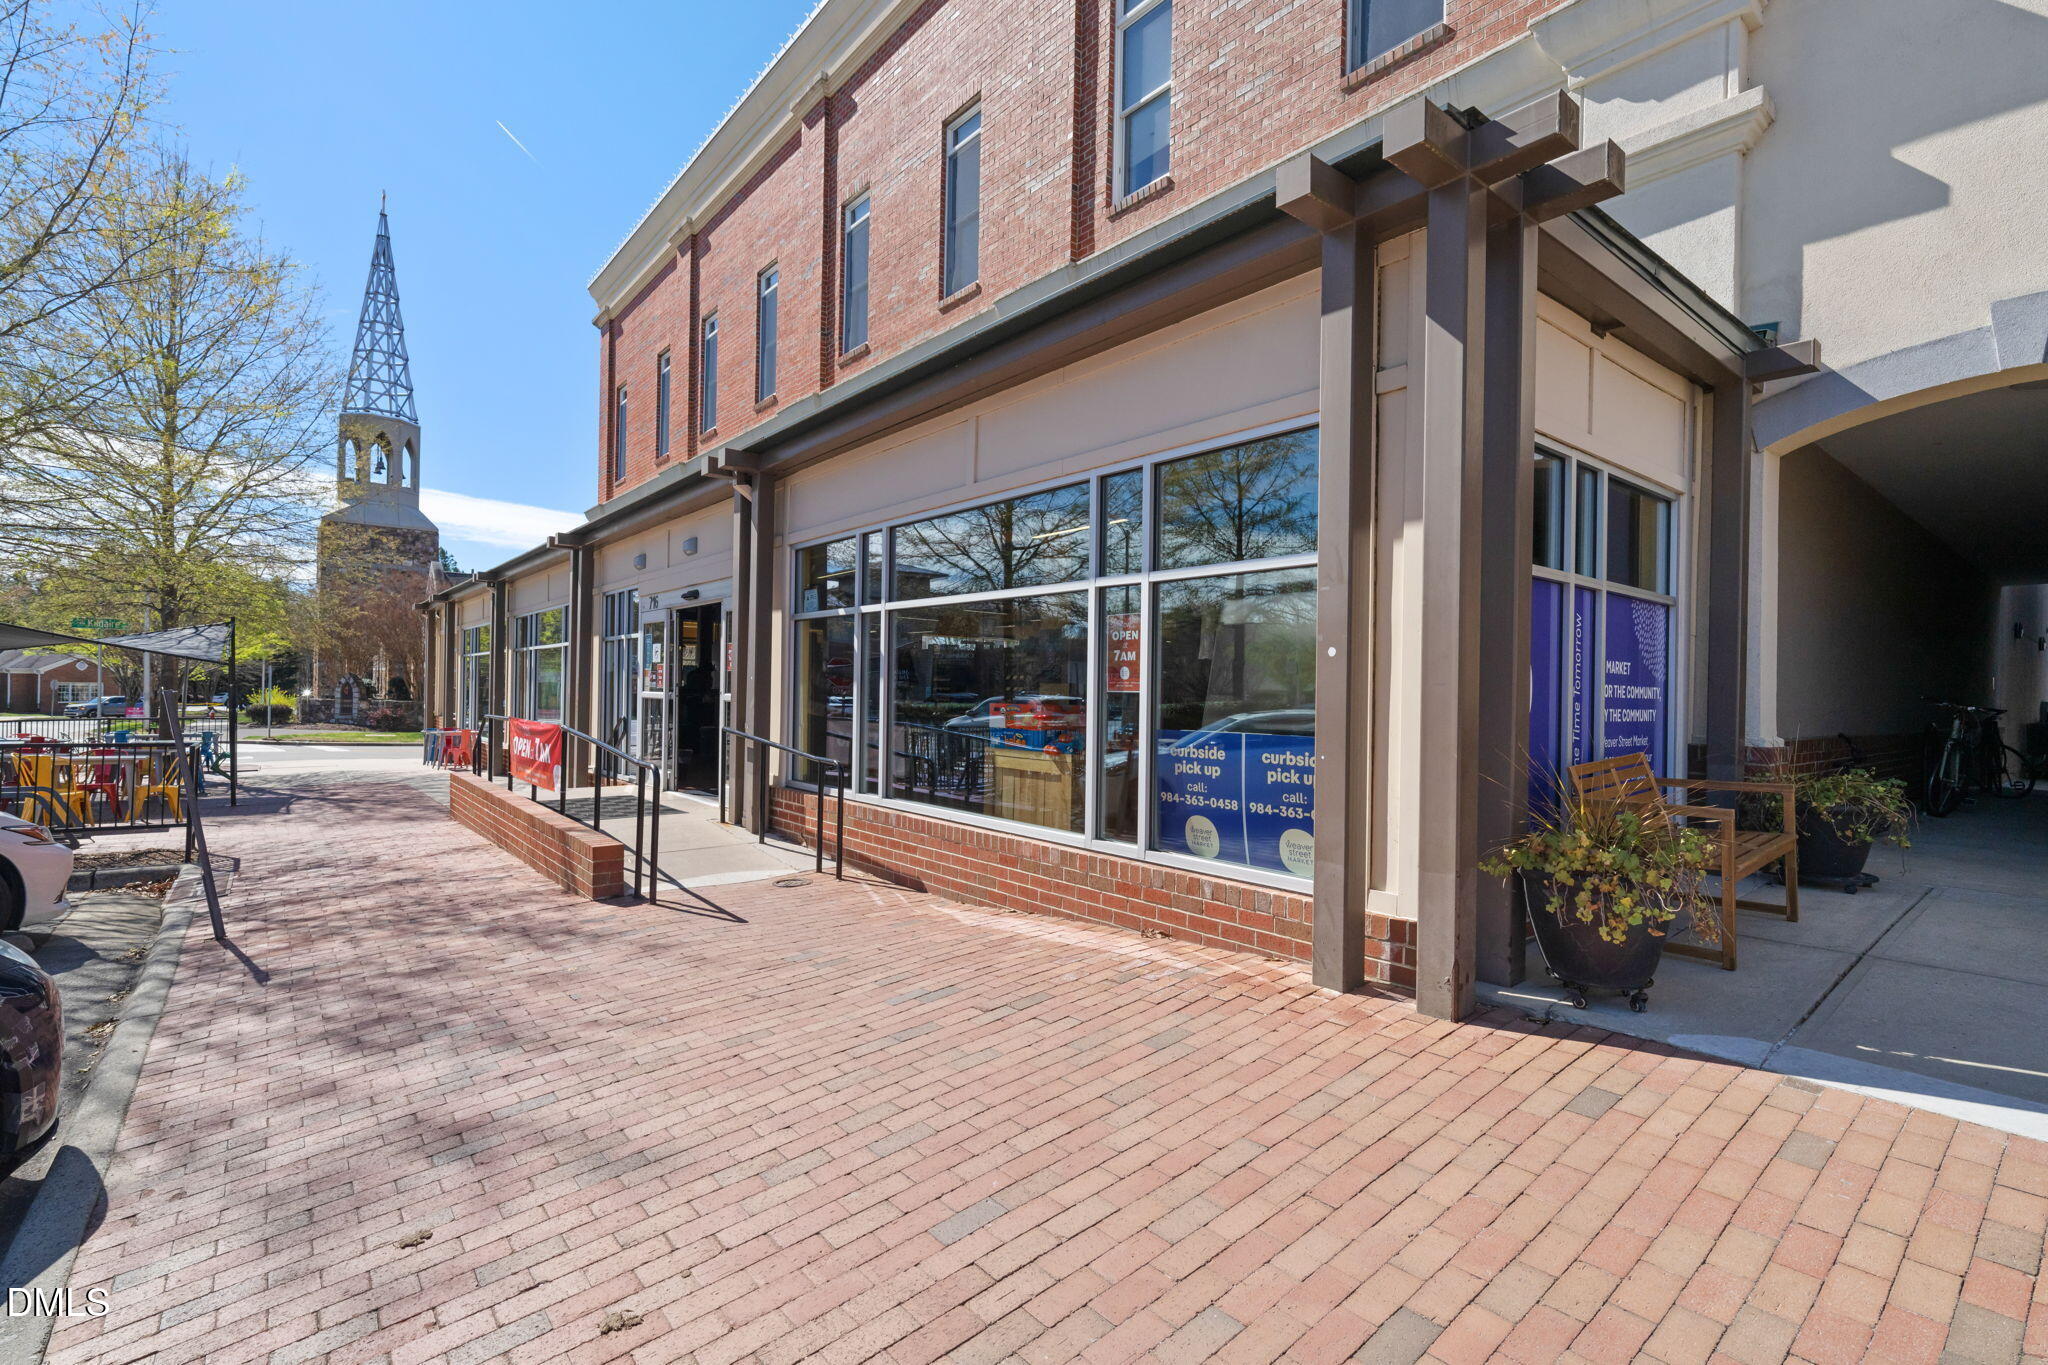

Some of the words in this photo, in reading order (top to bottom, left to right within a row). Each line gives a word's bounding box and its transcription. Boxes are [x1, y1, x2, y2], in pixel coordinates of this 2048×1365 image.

[648, 596, 659, 609] 716
[1112, 630, 1139, 641] OPEN
[1113, 649, 1137, 662] 7AM
[1573, 613, 1582, 696] Tomorrow
[1606, 660, 1632, 675] MARKET
[1613, 685, 1626, 699] THE
[1626, 686, 1662, 702] COMMUNITY,
[1609, 709, 1621, 722] THE
[1622, 709, 1657, 722] COMMUNITY
[1572, 702, 1581, 743] Time
[513, 735, 532, 759] OPEN
[1603, 736, 1618, 748] eaver
[1618, 735, 1632, 748] Street
[1632, 735, 1649, 747] Market
[1170, 745, 1226, 761] curbside
[1175, 760, 1202, 776] pick
[1204, 765, 1221, 779] up
[1267, 768, 1301, 785] pick
[1303, 774, 1316, 790] u
[1187, 782, 1208, 793] call:
[1160, 792, 1239, 811] 984-363-0458
[1282, 792, 1308, 805] call:
[1191, 840, 1213, 848] MARKET
[1192, 833, 1212, 843] street
[1288, 848, 1312, 859] street
